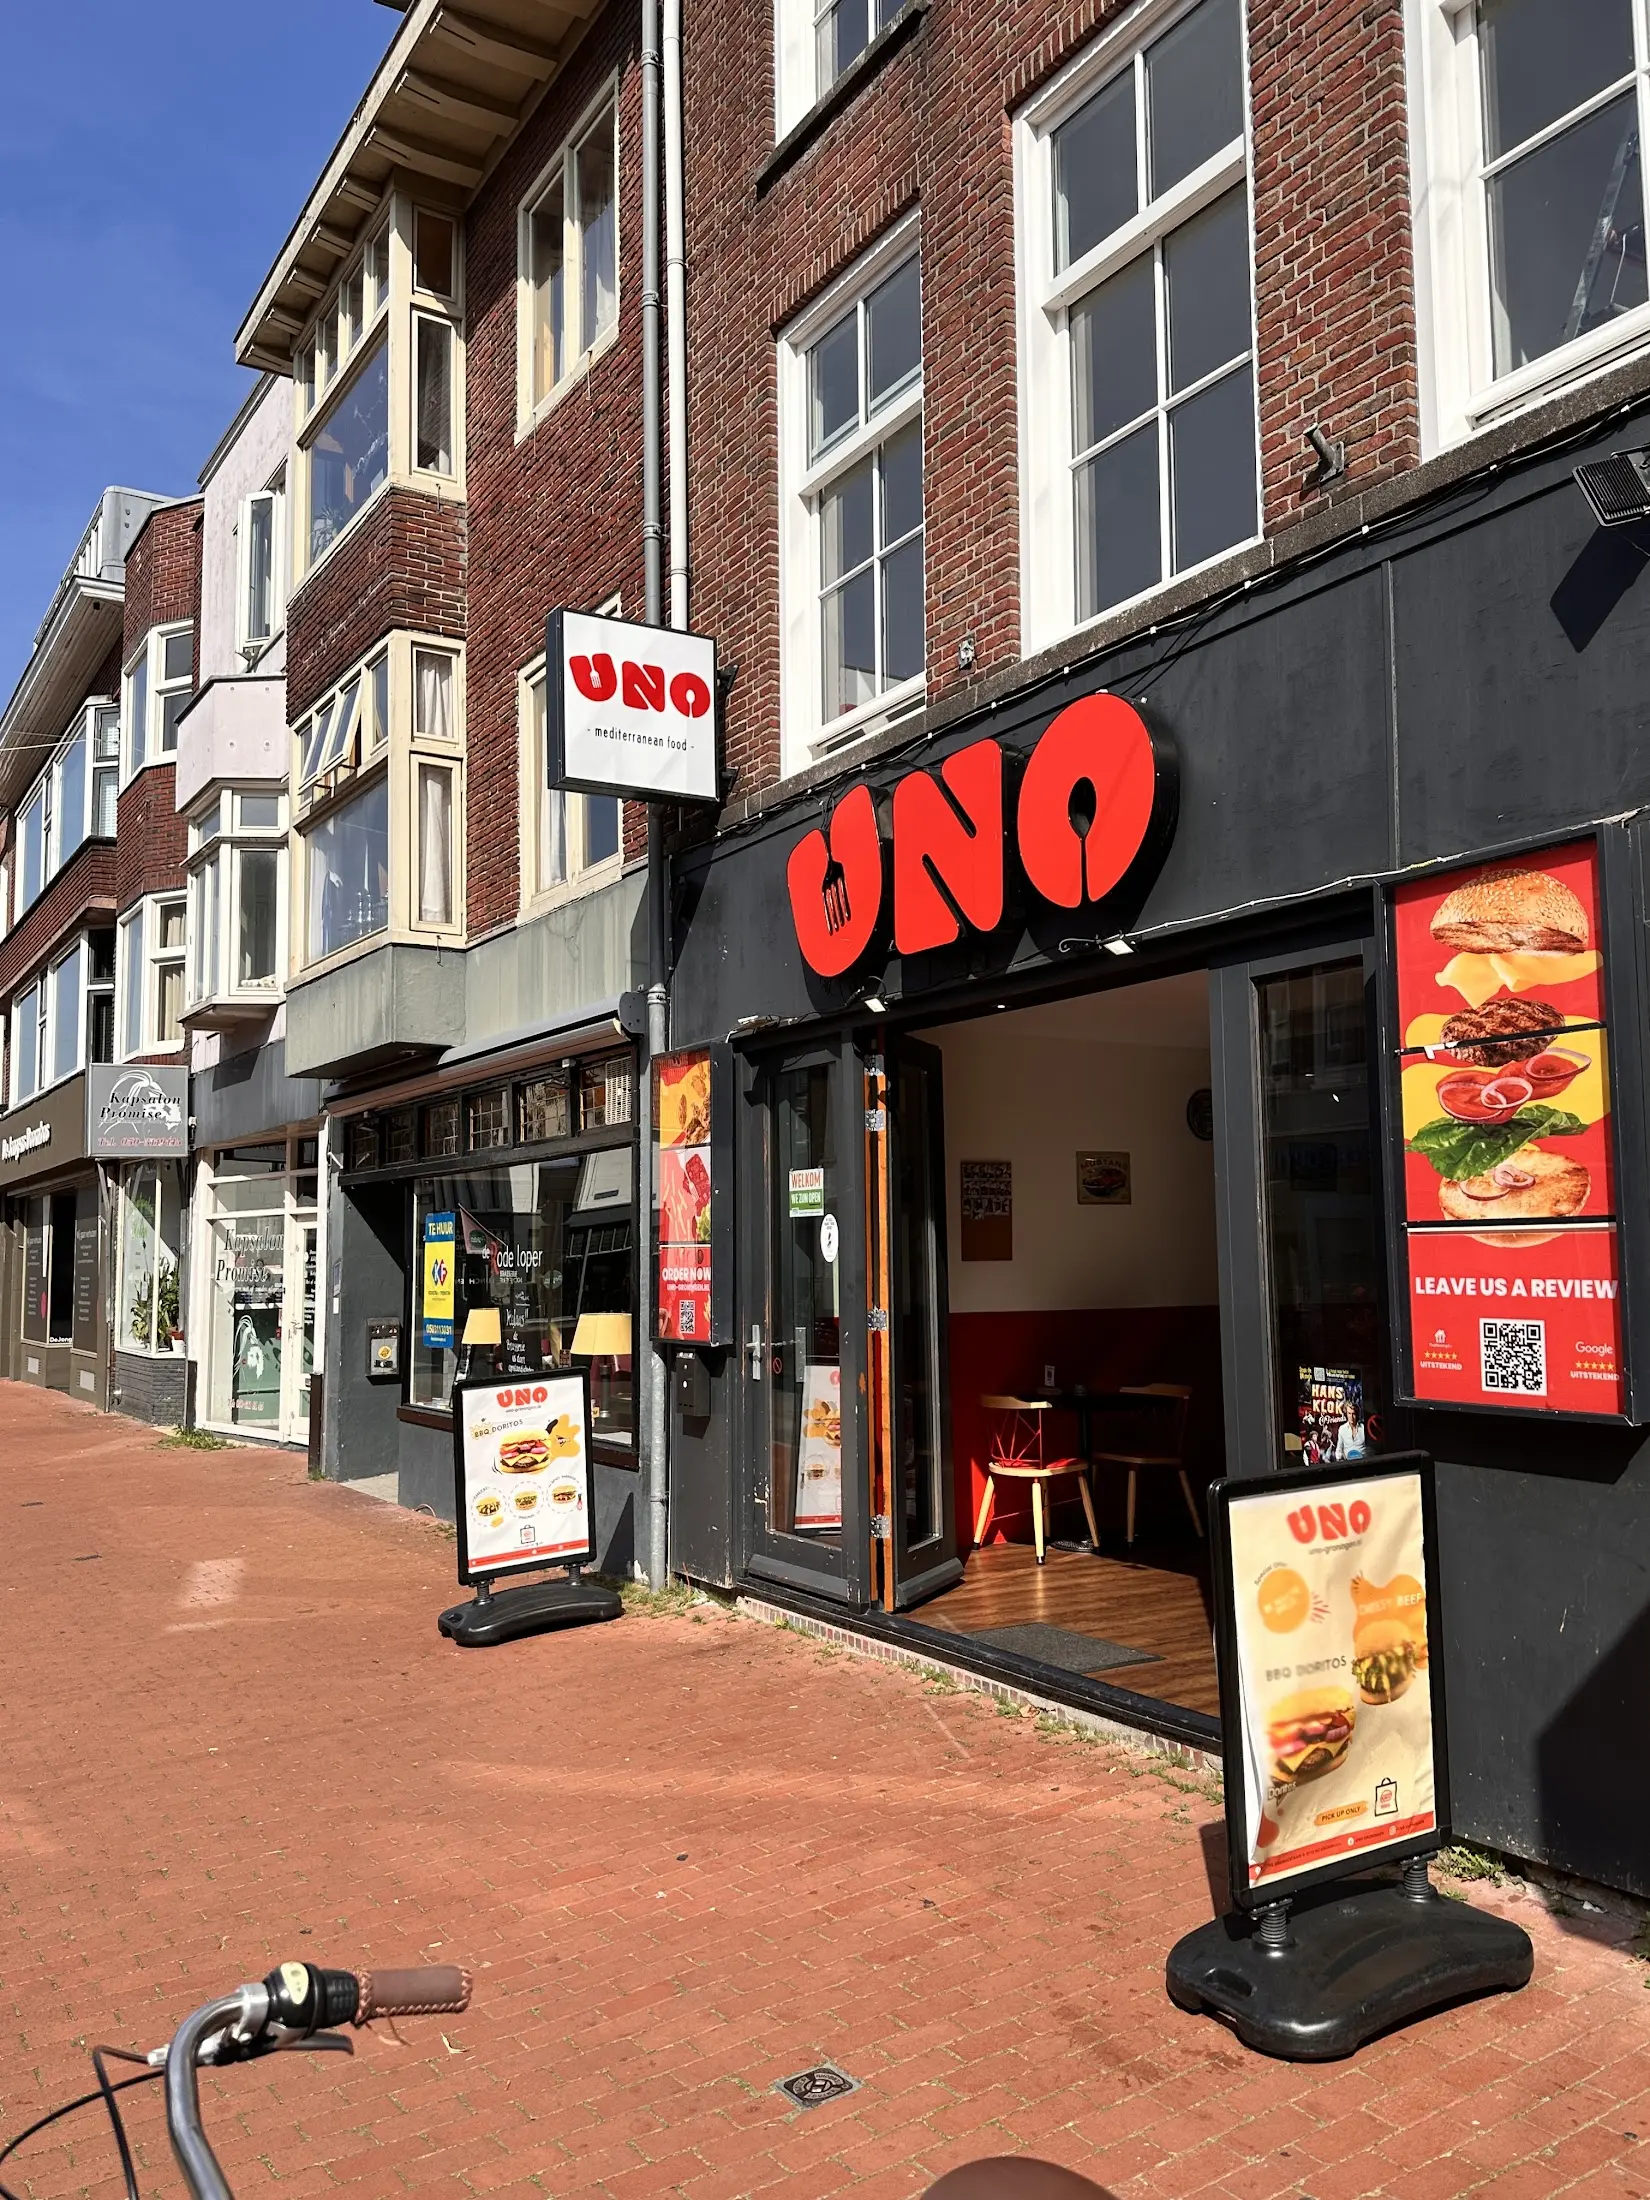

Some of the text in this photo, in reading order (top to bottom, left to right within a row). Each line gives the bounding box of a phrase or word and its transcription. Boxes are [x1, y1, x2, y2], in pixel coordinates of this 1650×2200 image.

[569, 653, 711, 718] UNO
[595, 727, 687, 751] mediterranean food
[786, 692, 1156, 977] UNO
[110, 1092, 181, 1106] Kapsalon
[100, 1107, 162, 1118] Promise
[791, 1172, 821, 1188] WELKOM
[791, 1193, 799, 1204] WE
[809, 1191, 821, 1203] OPEN
[428, 1221, 454, 1236] TE HUUR
[481, 1244, 490, 1259] de
[517, 1244, 543, 1273] loper
[662, 1266, 712, 1281] ORDER NOW
[1415, 1276, 1618, 1299] LEAVE US A REVIEW
[1575, 1341, 1614, 1357] Google
[1420, 1360, 1463, 1371] UITSTEKEND
[1570, 1370, 1620, 1381] UITSTEKEND
[496, 1386, 548, 1408] UNO
[1311, 1384, 1345, 1399] HANS
[1312, 1399, 1344, 1415] KLOK
[474, 1419, 523, 1438] BBQ DORITOS
[1286, 1500, 1372, 1544] UNO
[1397, 1592, 1422, 1607] BEEF
[1265, 1666, 1292, 1682] BBQ
[1321, 1805, 1362, 1821] PICK UP ONLY
